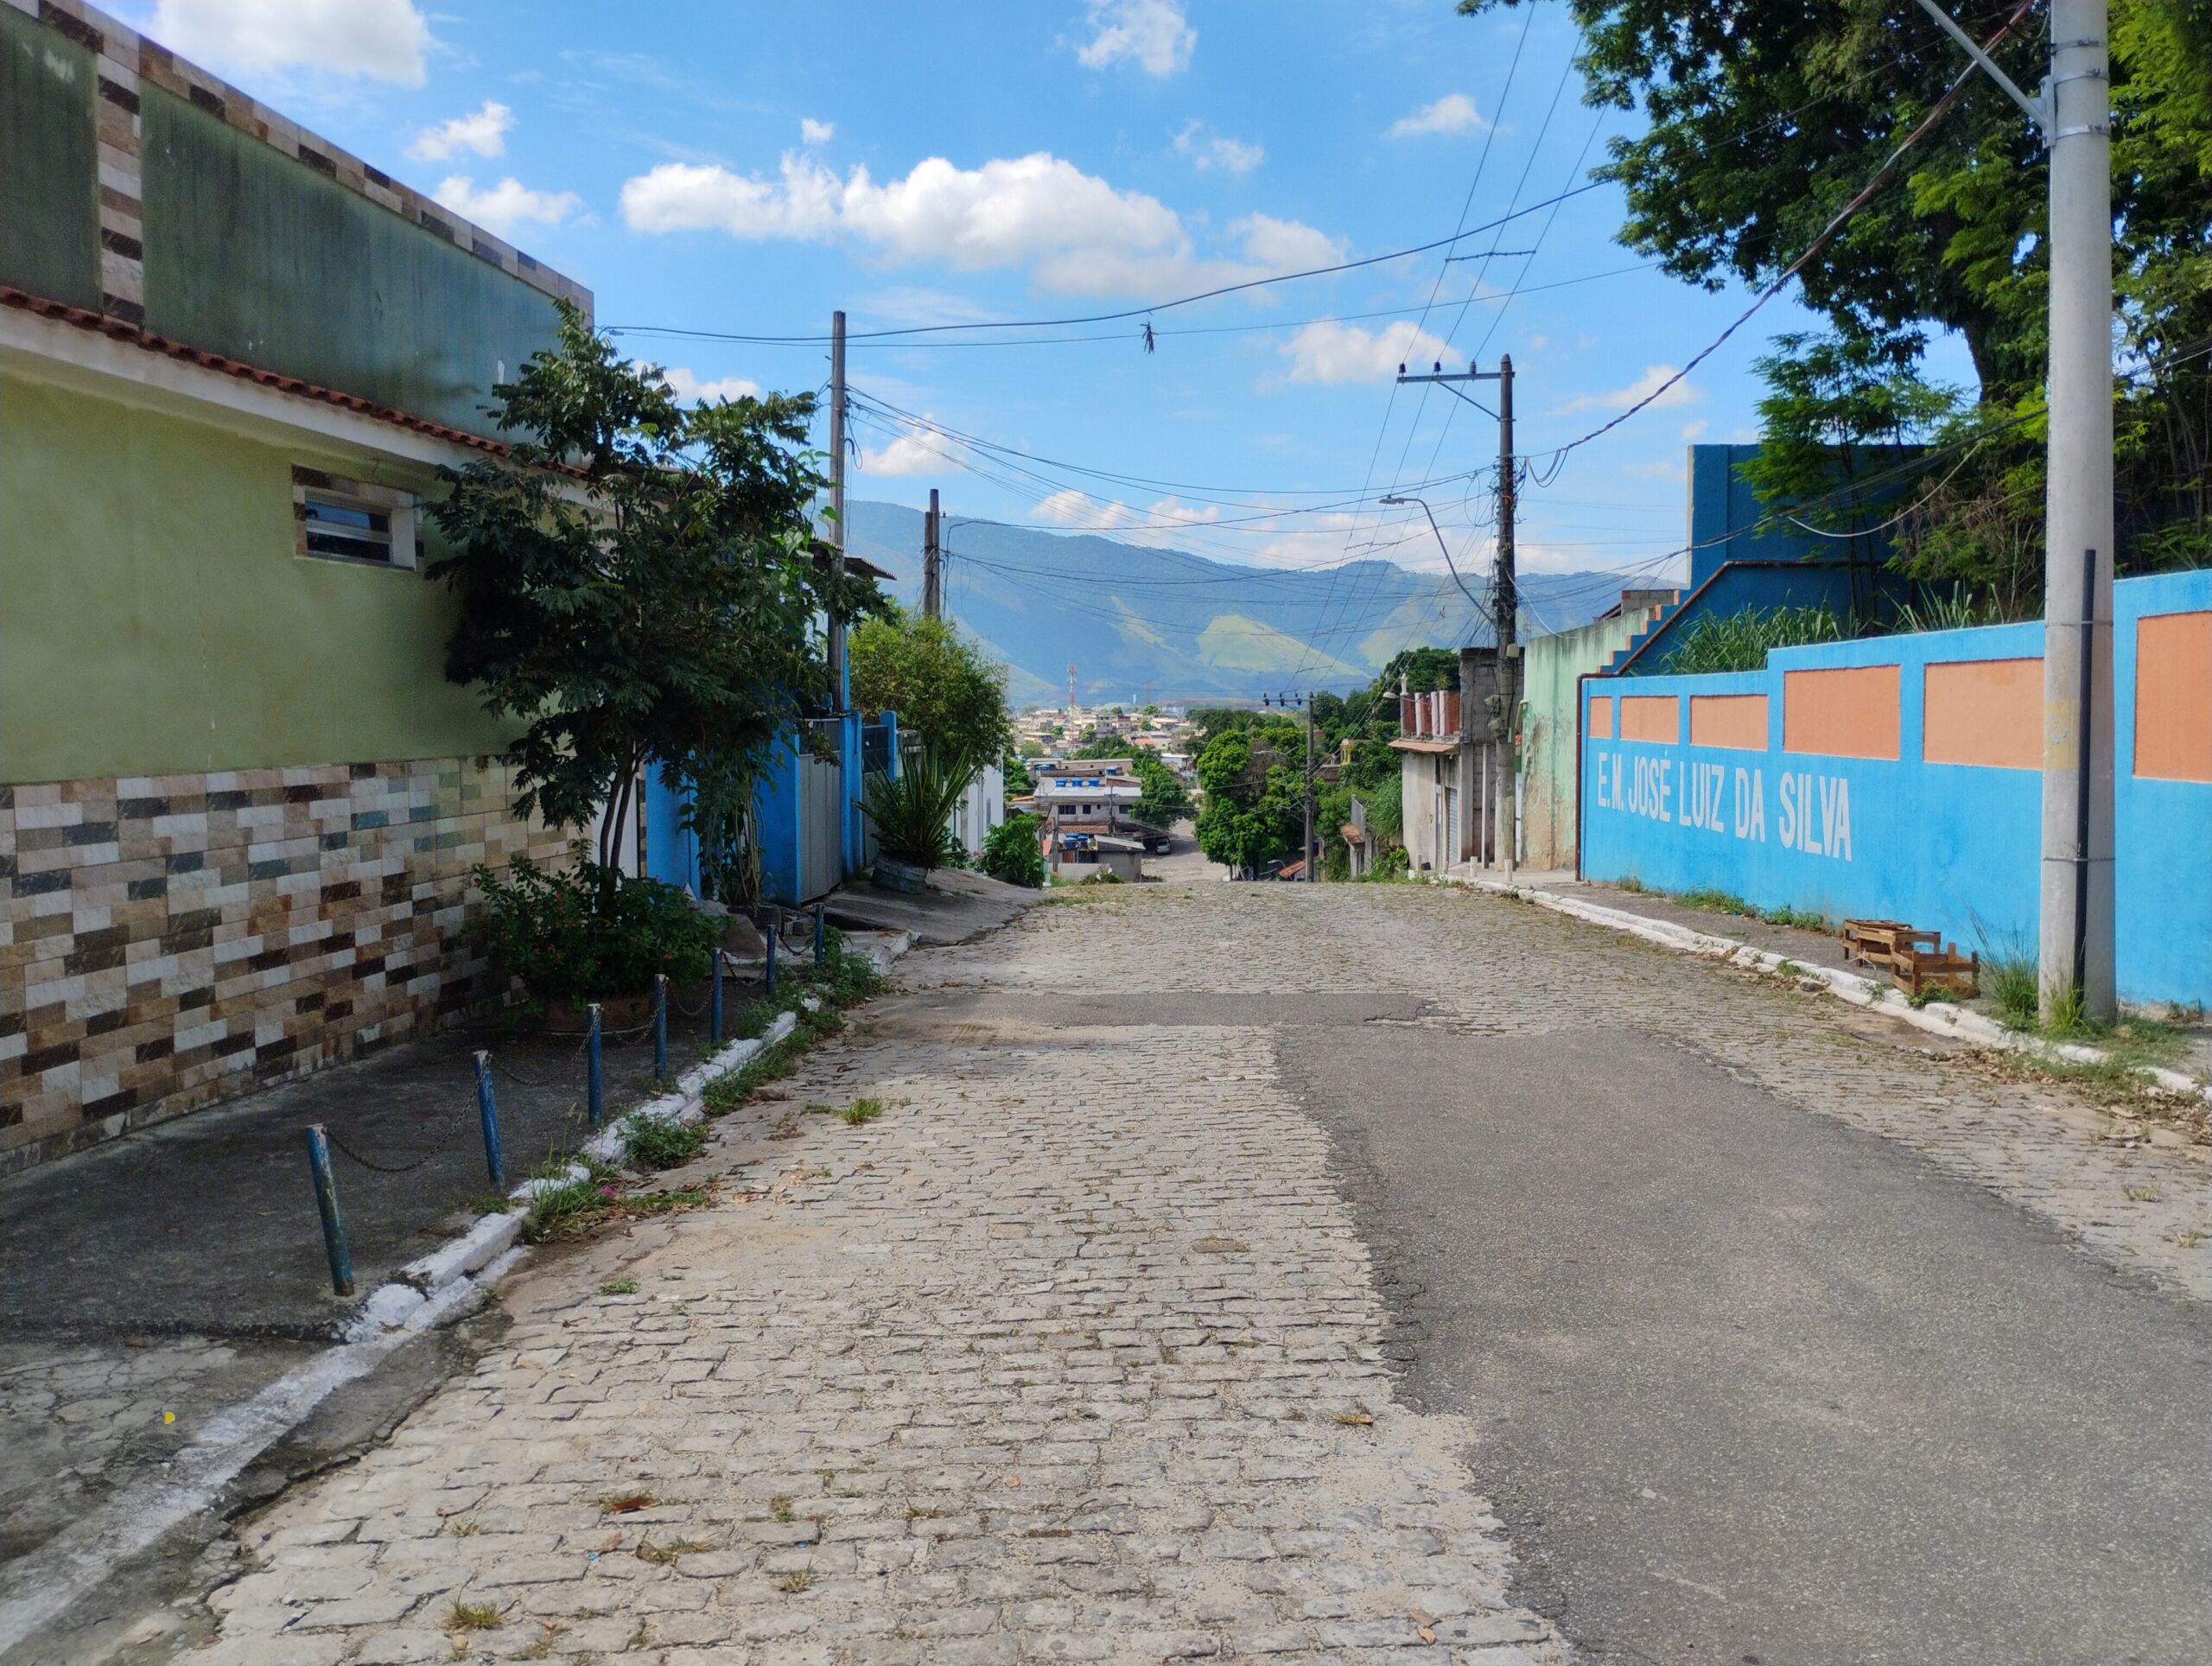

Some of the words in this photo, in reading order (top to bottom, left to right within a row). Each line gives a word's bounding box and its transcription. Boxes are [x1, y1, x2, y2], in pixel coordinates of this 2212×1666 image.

[1628, 748, 1671, 823] JOSÉ
[1679, 760, 1725, 833] LUIZ
[1735, 767, 1765, 843] DA
[1778, 771, 1853, 862] SILVA
